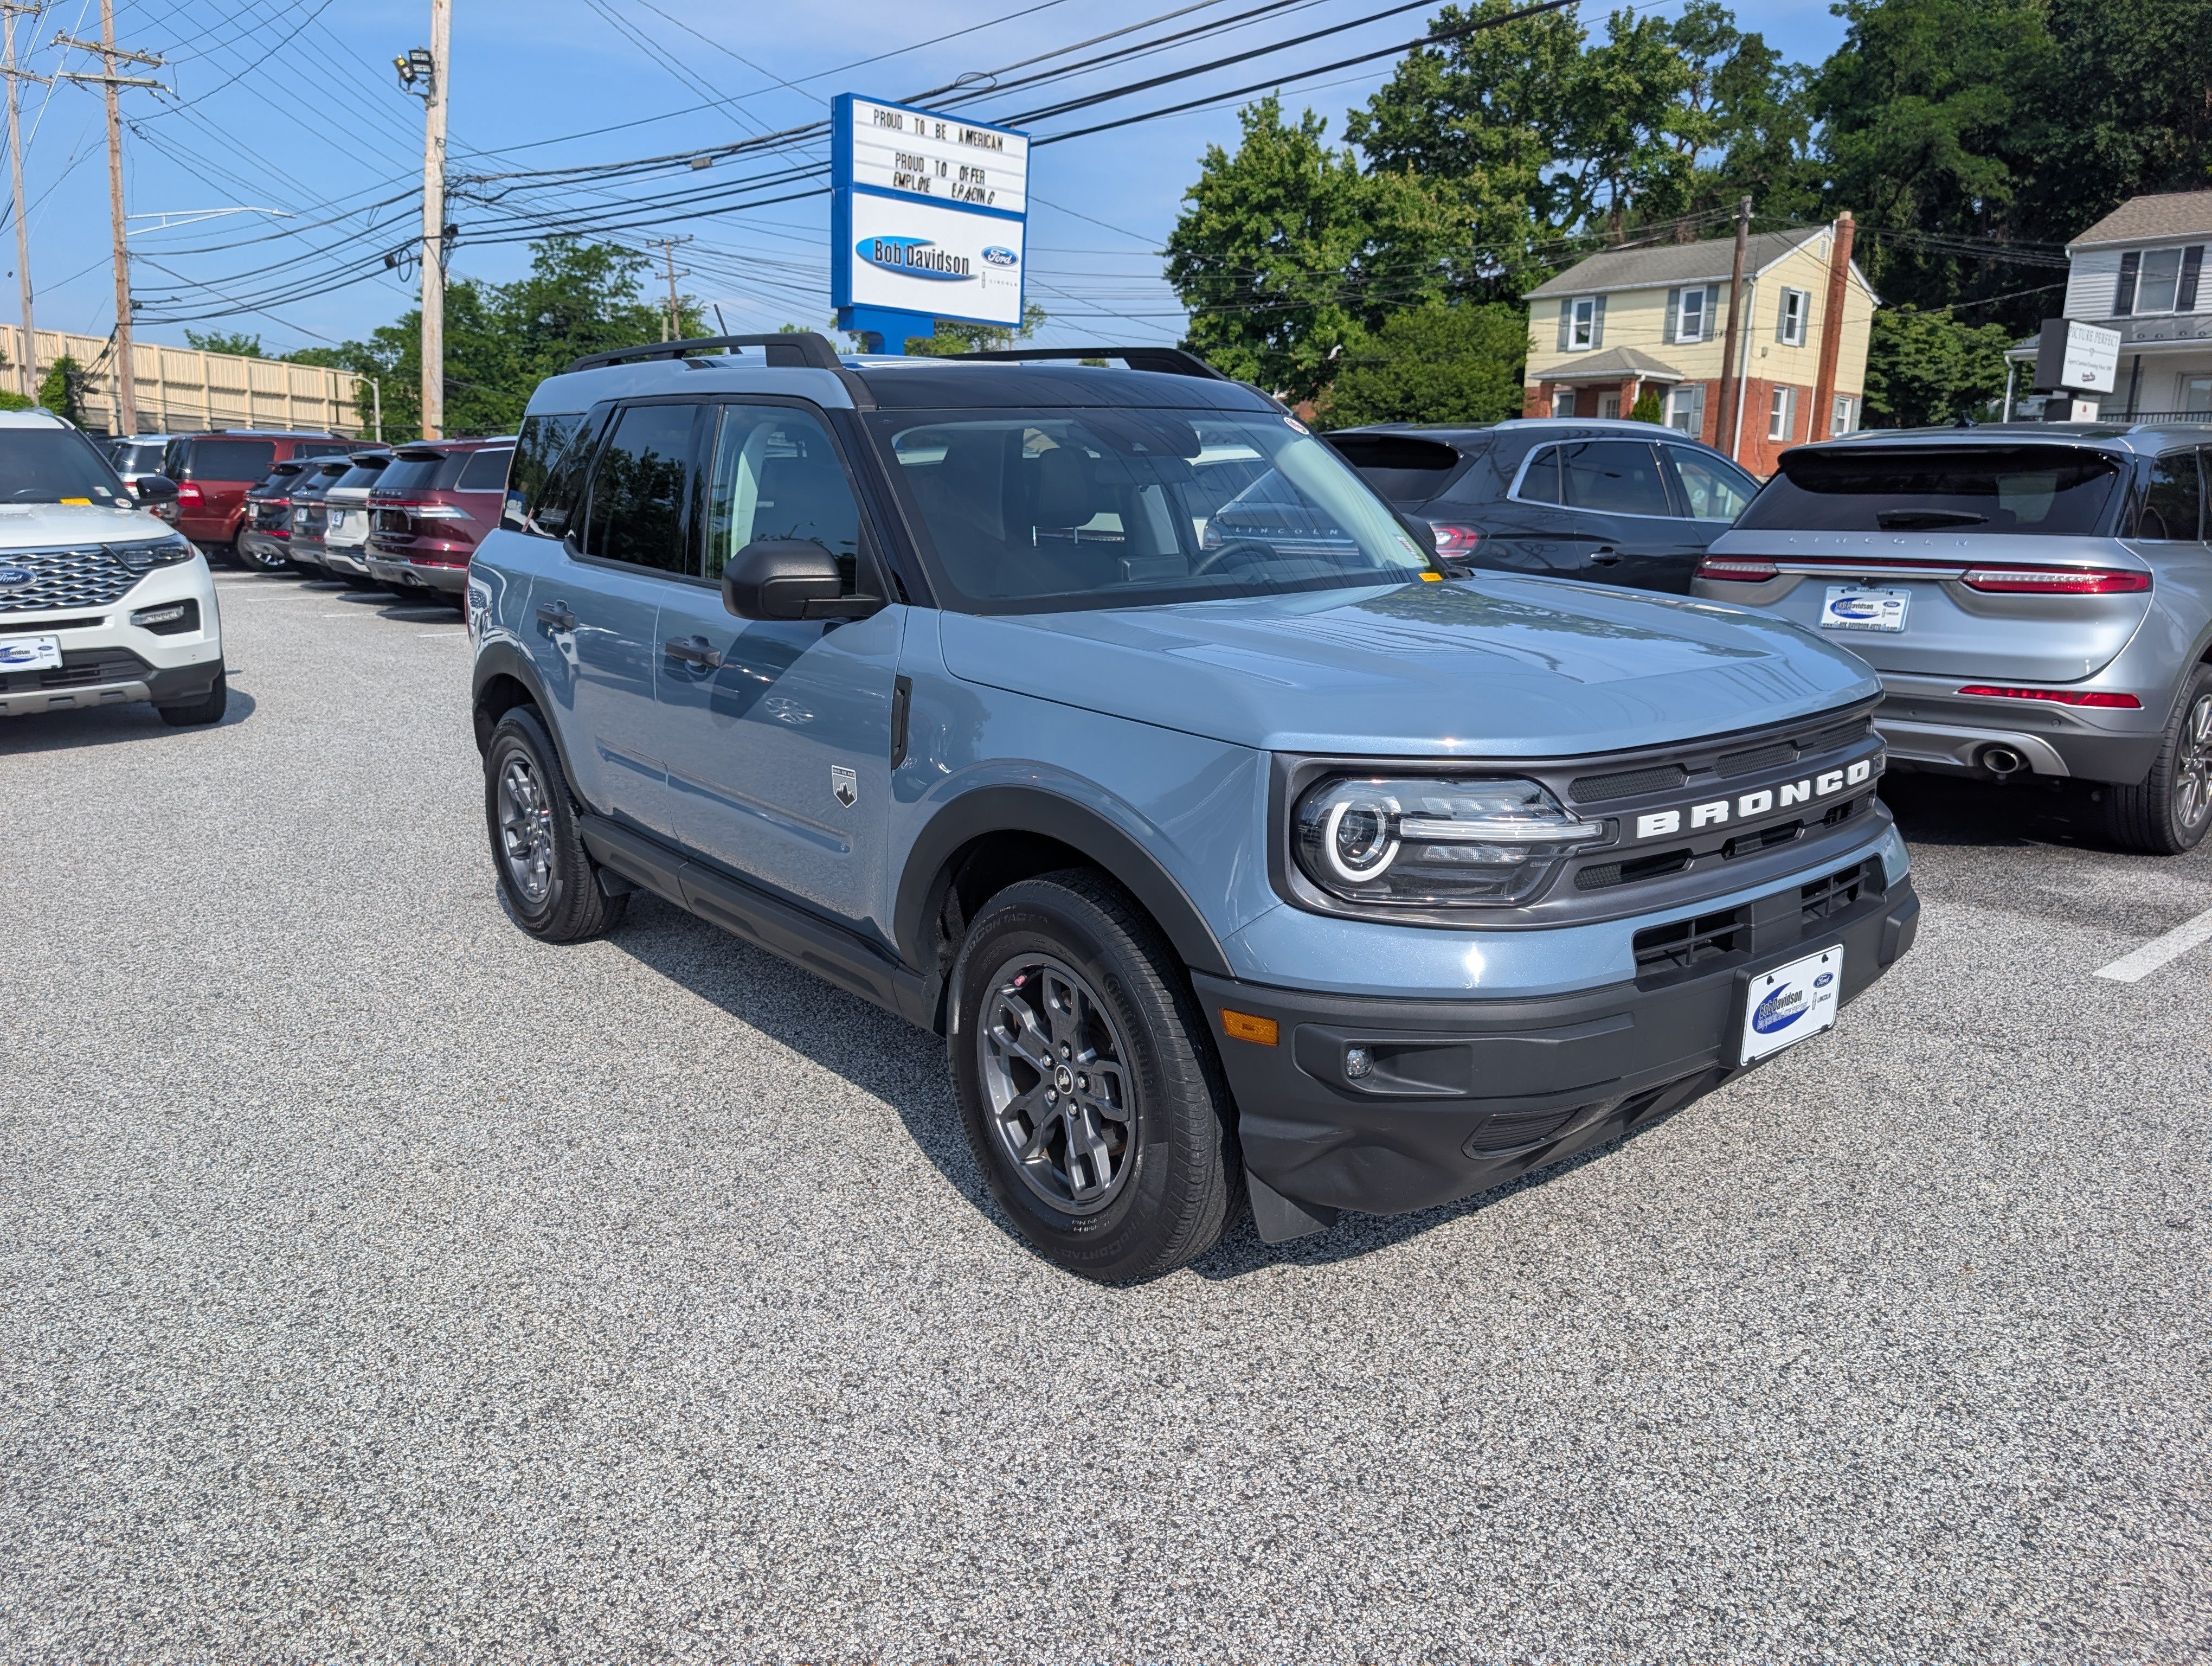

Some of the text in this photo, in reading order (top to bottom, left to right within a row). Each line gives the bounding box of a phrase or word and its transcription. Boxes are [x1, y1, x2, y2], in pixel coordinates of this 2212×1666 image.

[873, 110, 1003, 152] PROUD TO BE AMERICAN
[896, 152, 985, 185] PROUD TO OFFER
[874, 239, 969, 275] Bob Davidson
[987, 249, 1013, 263] Ford
[2068, 325, 2119, 347] PICTURE PERFECT
[1235, 527, 1338, 535] LINCOLN
[1789, 537, 1969, 547] LINCOLN
[1848, 601, 1874, 611] Davidson
[1636, 759, 1869, 838] BRONCO
[1817, 975, 1830, 986] Ford
[1760, 1000, 1773, 1018] Bob
[1773, 989, 1803, 1011] Davidson
[1817, 992, 1831, 1003] LINCOLN
